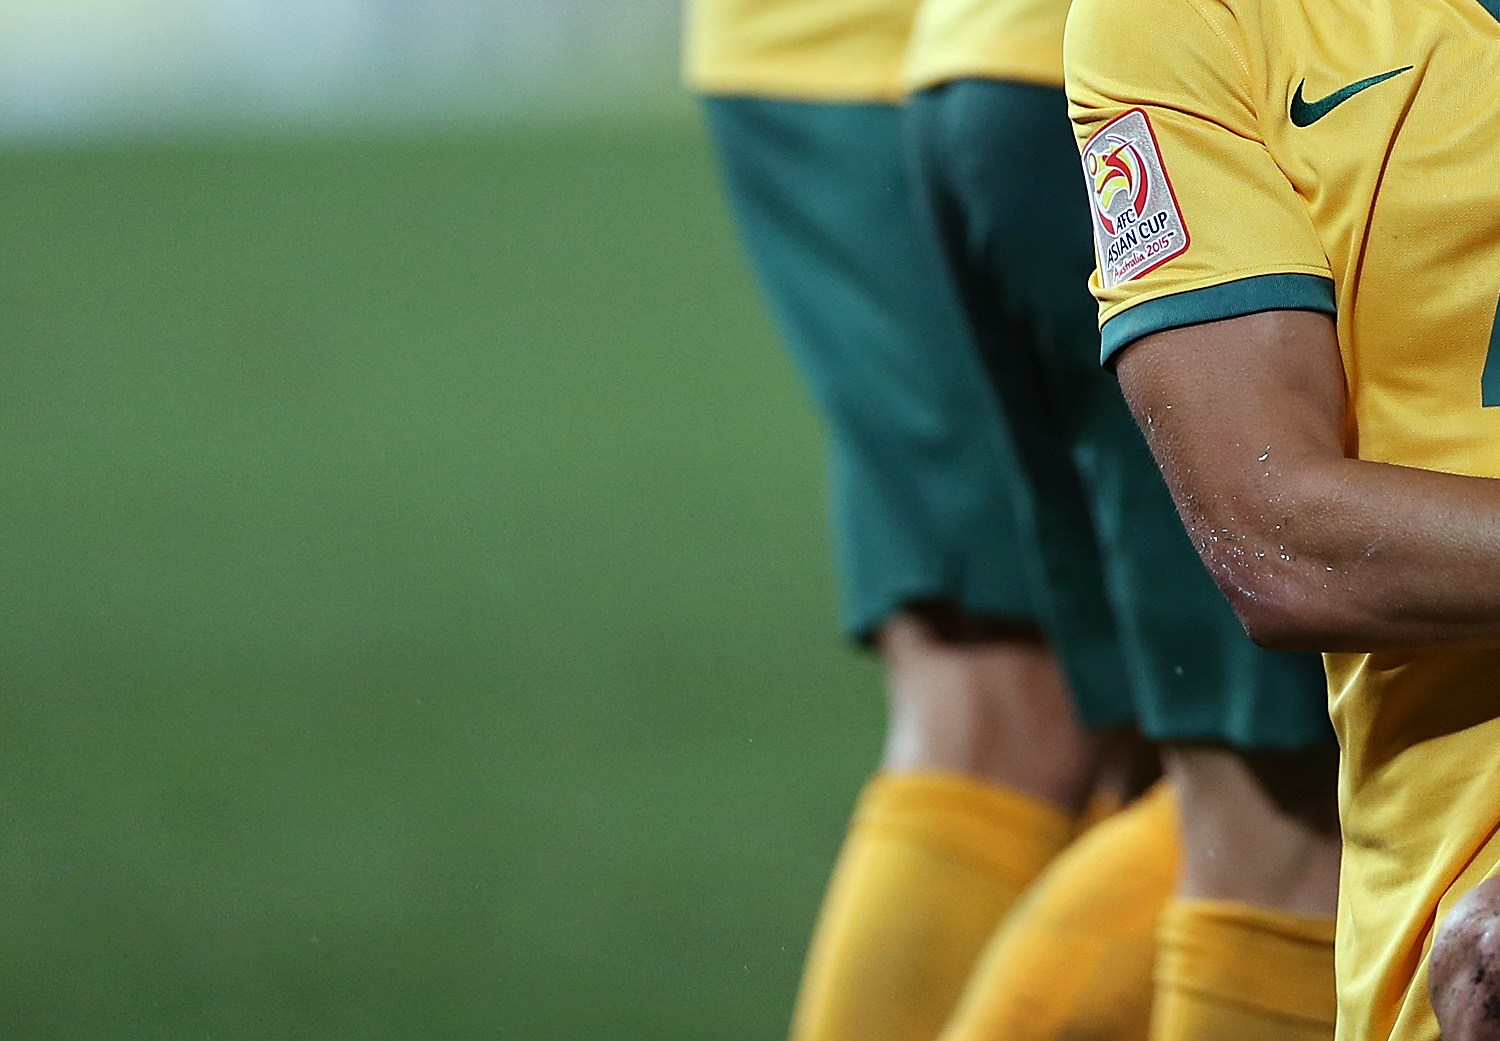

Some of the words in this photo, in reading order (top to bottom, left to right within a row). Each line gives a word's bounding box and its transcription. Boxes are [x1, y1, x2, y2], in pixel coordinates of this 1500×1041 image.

[1117, 208, 1136, 234] AFC
[1107, 228, 1138, 268] ASIAN
[1138, 211, 1168, 239] CUP
[1113, 252, 1146, 282] Australia
